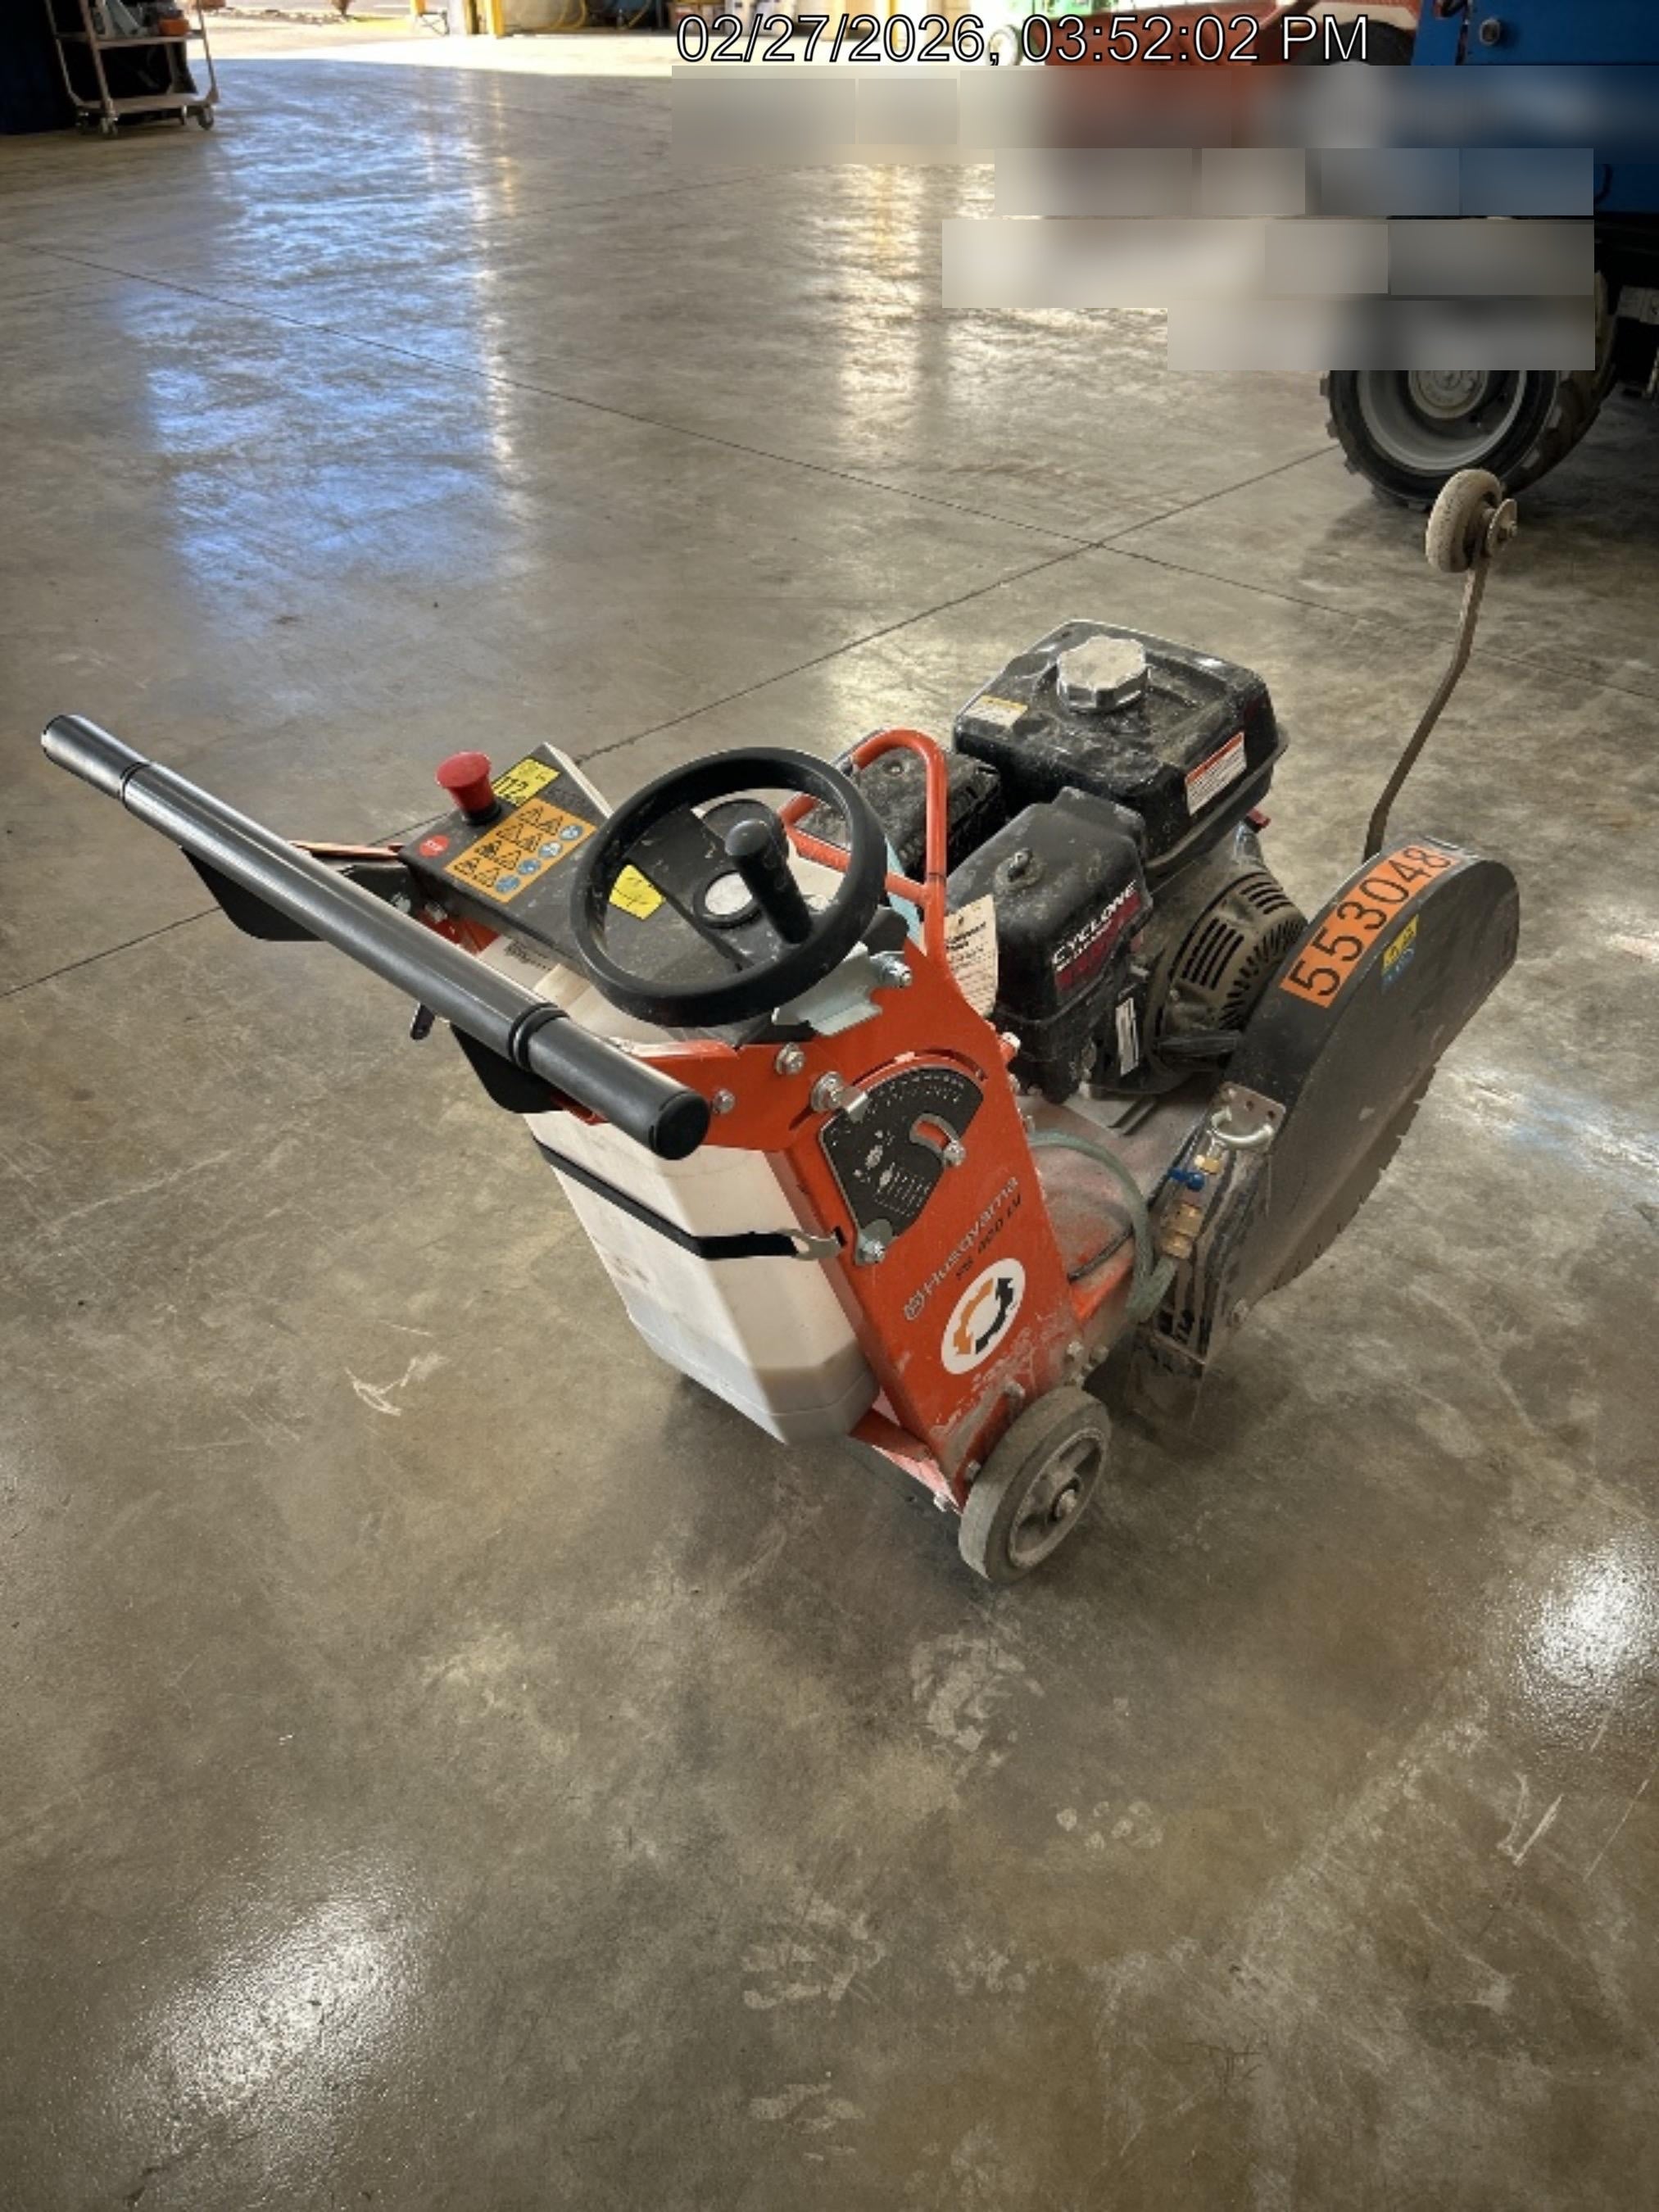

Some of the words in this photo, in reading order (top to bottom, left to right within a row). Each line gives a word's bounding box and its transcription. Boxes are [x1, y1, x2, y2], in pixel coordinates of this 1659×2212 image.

[1052, 878, 1137, 965] CYCLONE
[1289, 846, 1451, 996] 553048
[922, 1176, 1018, 1296] Husqvarna
